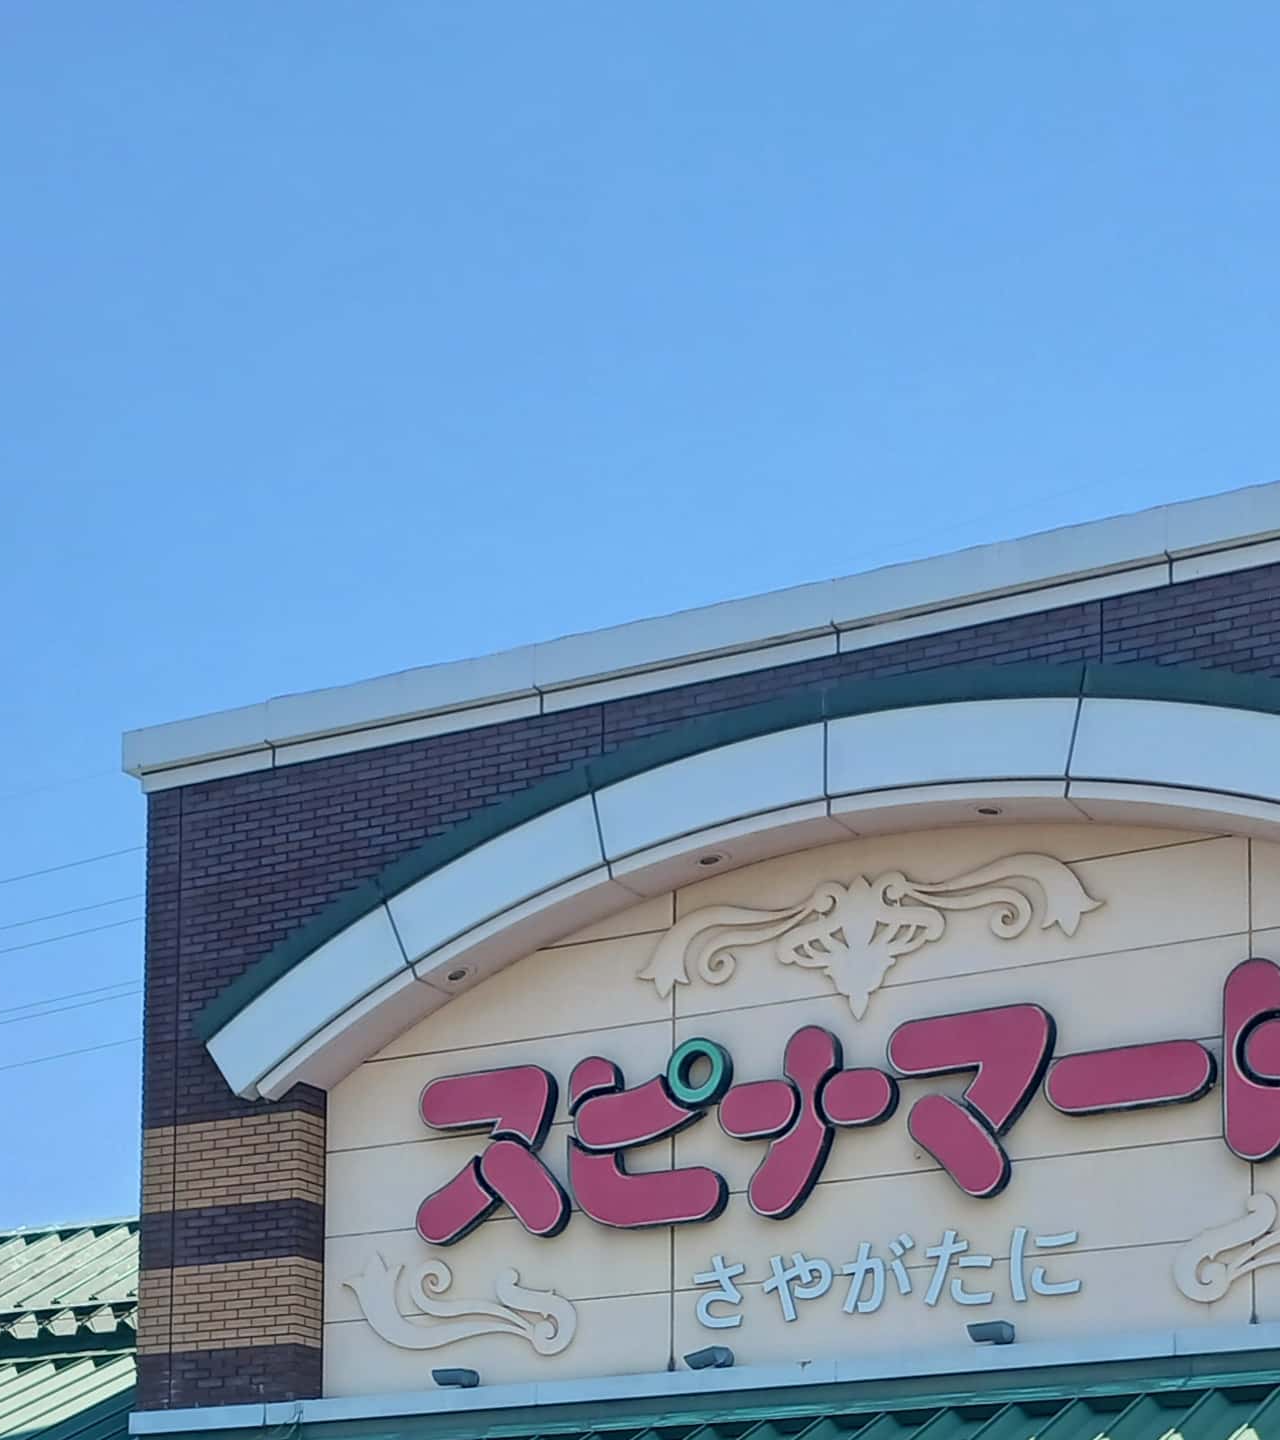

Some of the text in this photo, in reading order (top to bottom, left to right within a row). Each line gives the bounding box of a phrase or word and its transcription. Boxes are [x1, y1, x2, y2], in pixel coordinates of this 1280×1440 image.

[692, 1226, 1082, 1328] さやがたに
